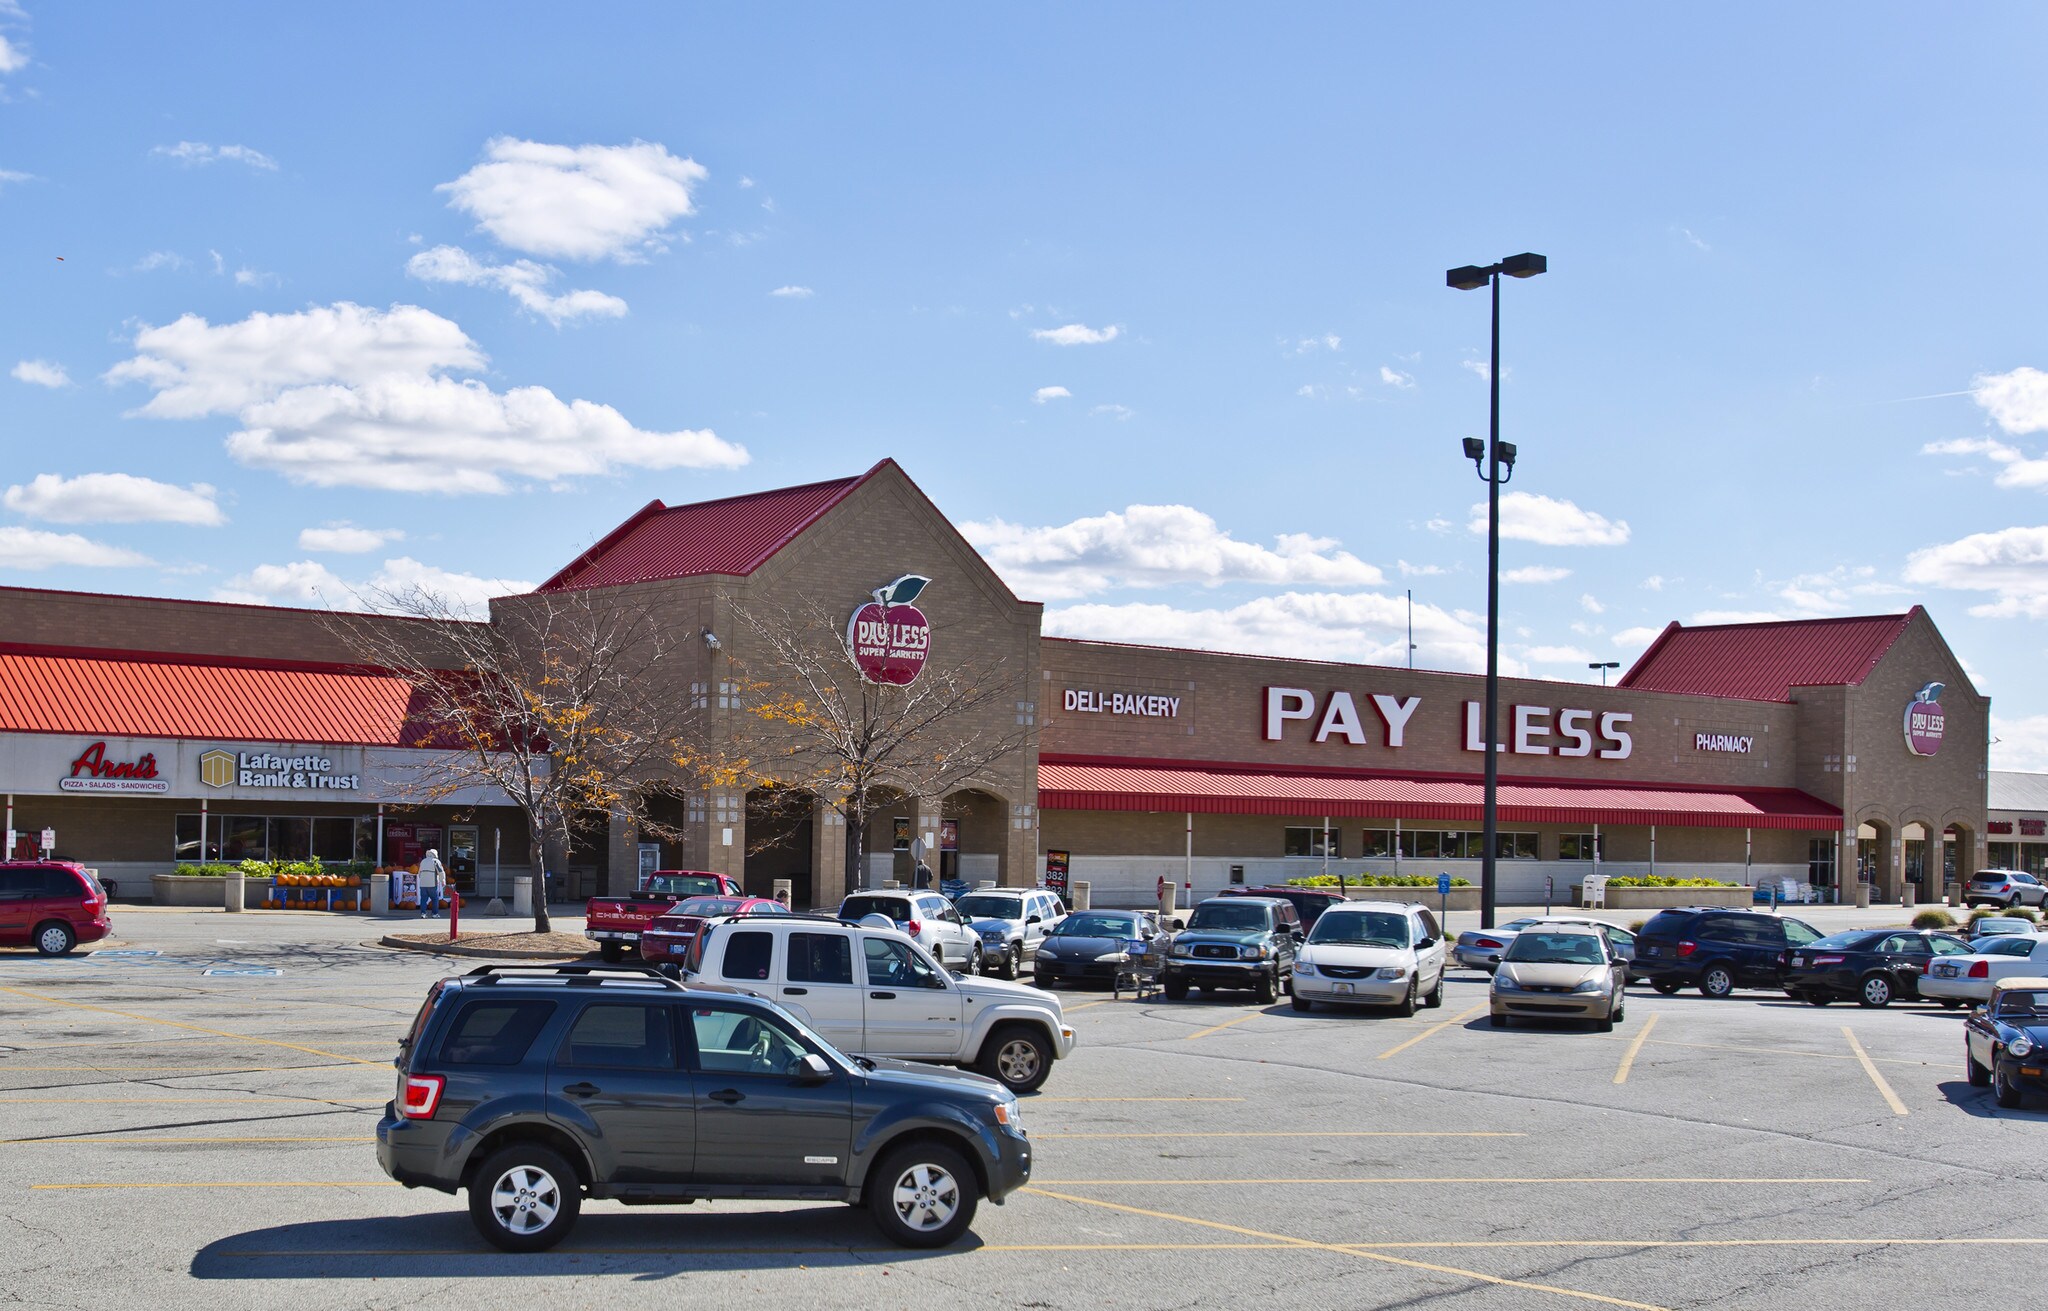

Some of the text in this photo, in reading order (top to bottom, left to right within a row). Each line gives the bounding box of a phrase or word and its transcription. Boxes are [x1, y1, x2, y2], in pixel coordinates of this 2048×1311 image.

[858, 621, 928, 649] PAY LESS
[859, 646, 925, 660] SUPER MARKETS
[1064, 689, 1180, 717] DELI-BAKERY
[1263, 686, 1633, 760] PAY LESS
[1912, 713, 1944, 731] PAY LESS
[1695, 733, 1753, 753] PHARMACY
[71, 741, 159, 778] Arni's
[240, 752, 331, 775] Lafayette
[89, 780, 116, 788] SALADS
[121, 782, 166, 790] SANDWICHES
[1046, 870, 1063, 881] 382
[596, 912, 655, 920] CHEVROL
